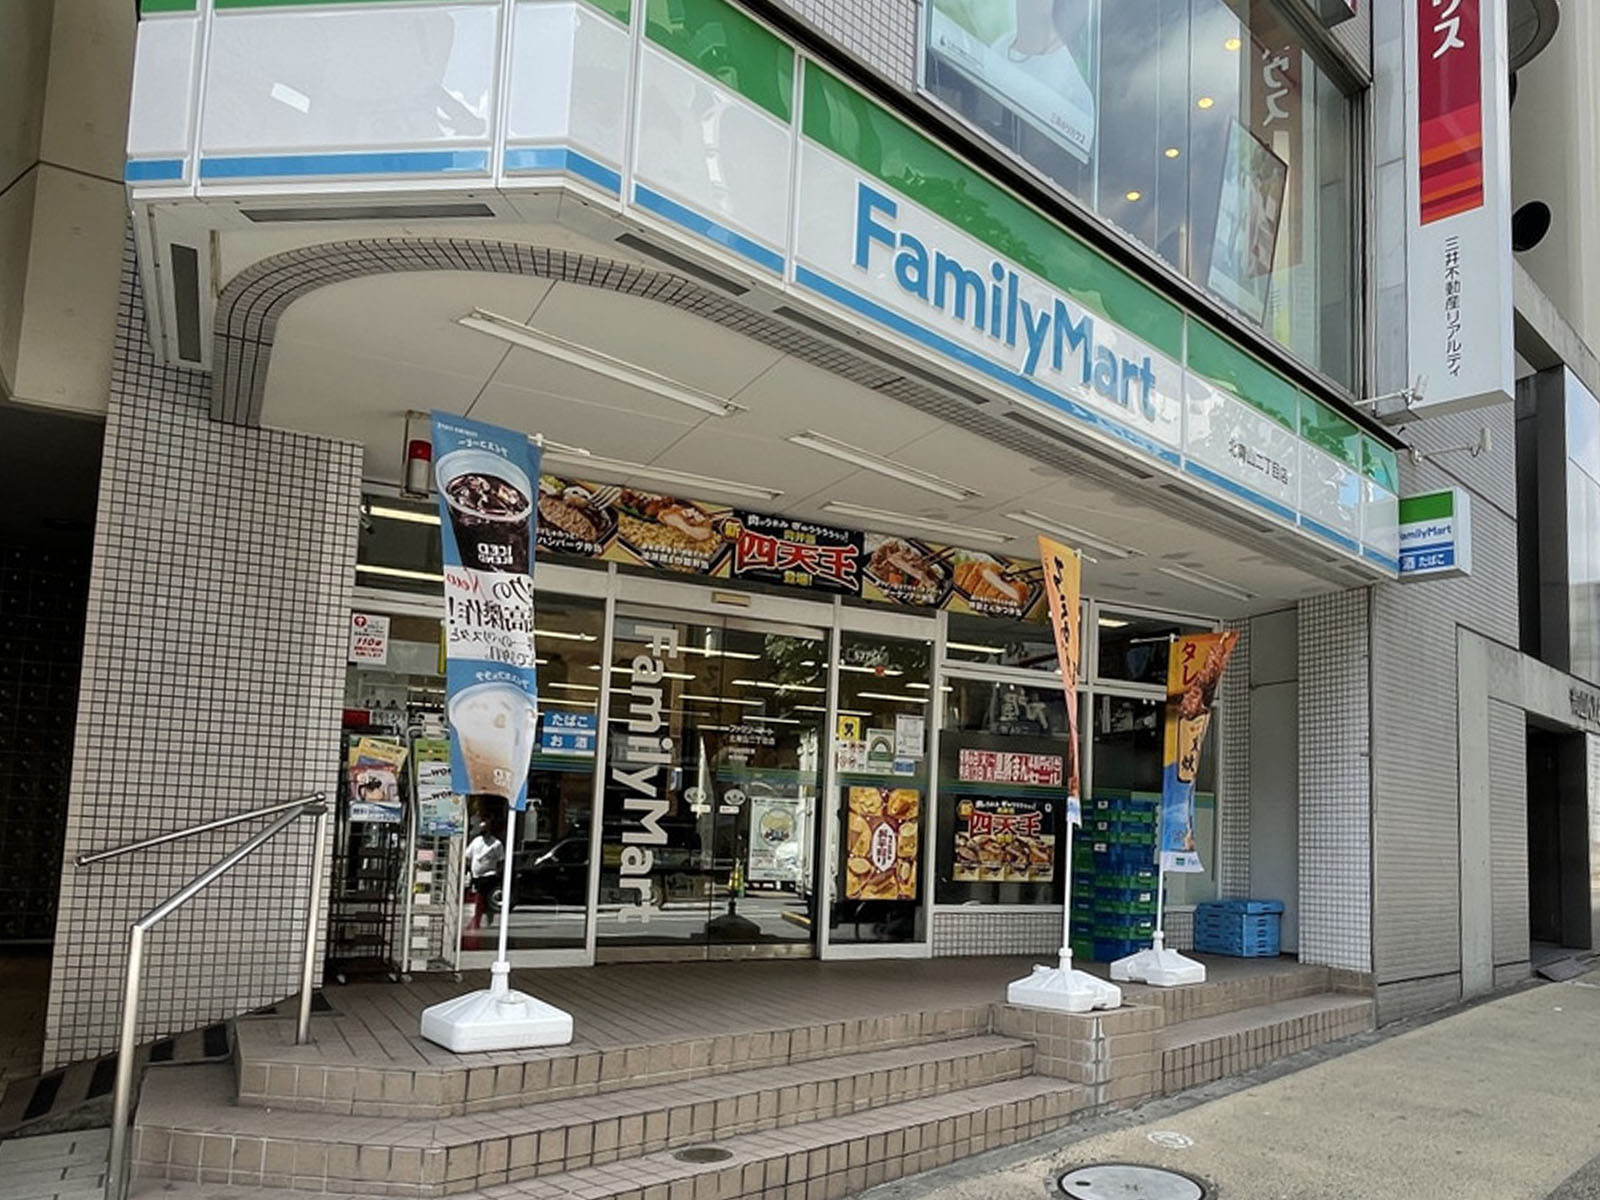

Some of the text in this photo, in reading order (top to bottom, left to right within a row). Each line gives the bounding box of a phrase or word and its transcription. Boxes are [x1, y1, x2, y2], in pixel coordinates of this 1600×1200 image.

[853, 181, 1157, 423] FamilyMart
[1445, 235, 1462, 377] 三井不動産リアルティ
[1399, 524, 1452, 541] amilyMart
[735, 530, 859, 591] 四天王
[1418, 554, 1445, 568] たばこ
[1181, 642, 1198, 686] タレ
[551, 713, 589, 728] たばこ
[612, 624, 680, 924] FamilyMart
